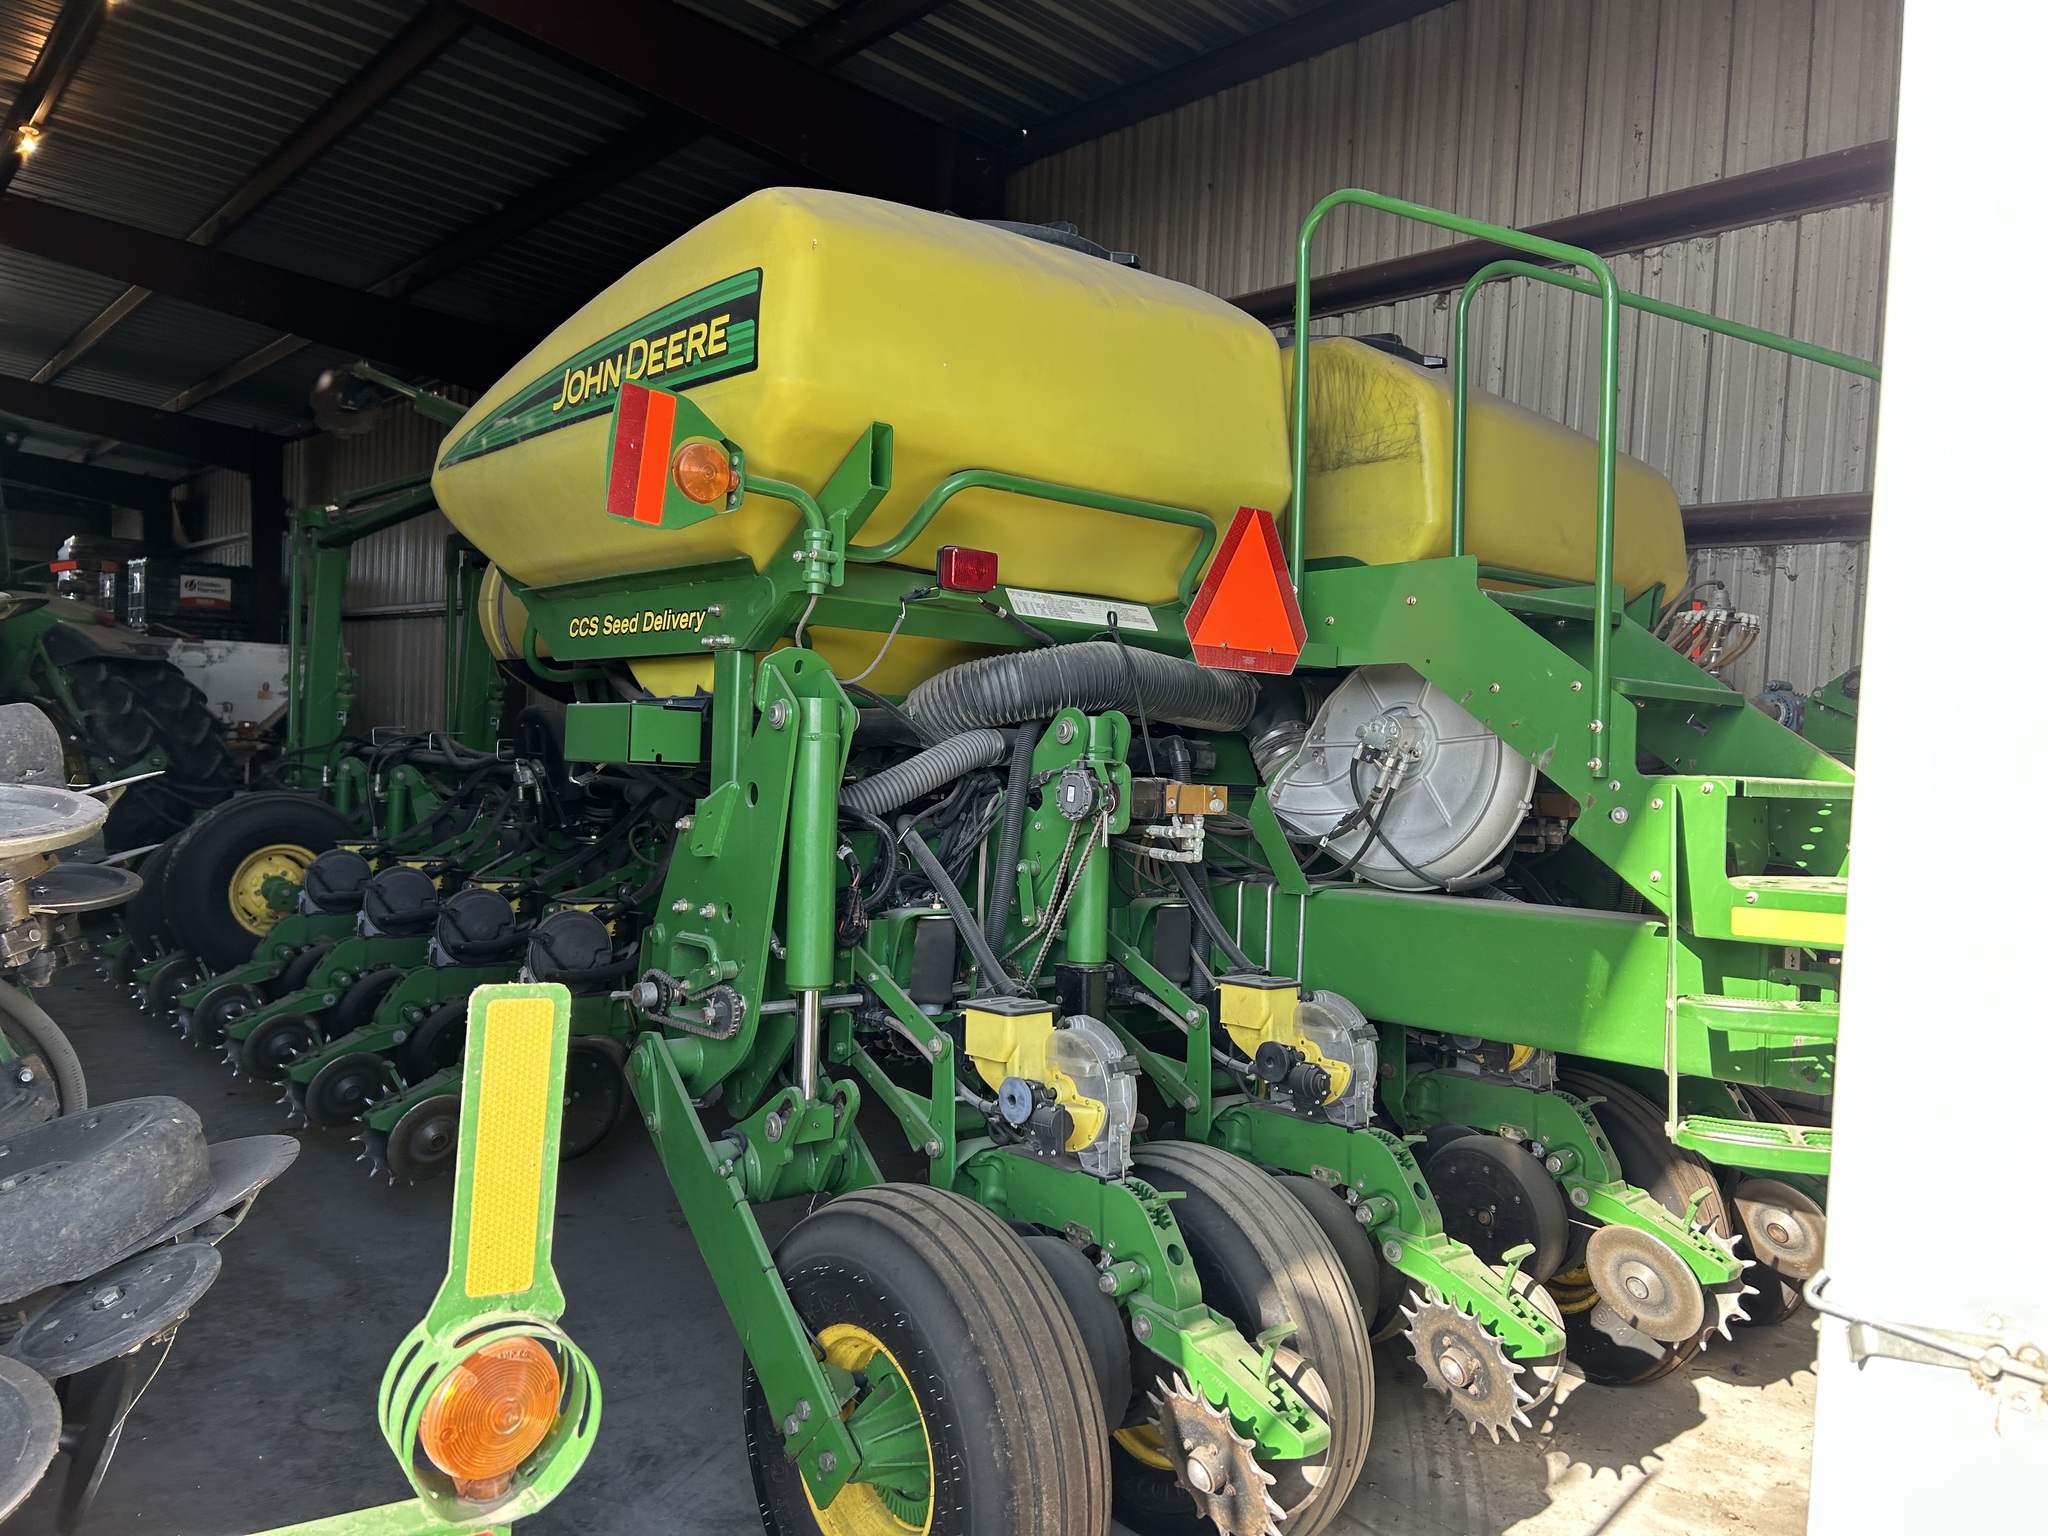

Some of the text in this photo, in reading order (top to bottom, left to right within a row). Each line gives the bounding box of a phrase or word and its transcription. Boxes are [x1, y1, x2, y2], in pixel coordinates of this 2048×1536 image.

[552, 313, 731, 411] JOHN DEERE
[569, 608, 707, 638] CCS Seed Delivery
